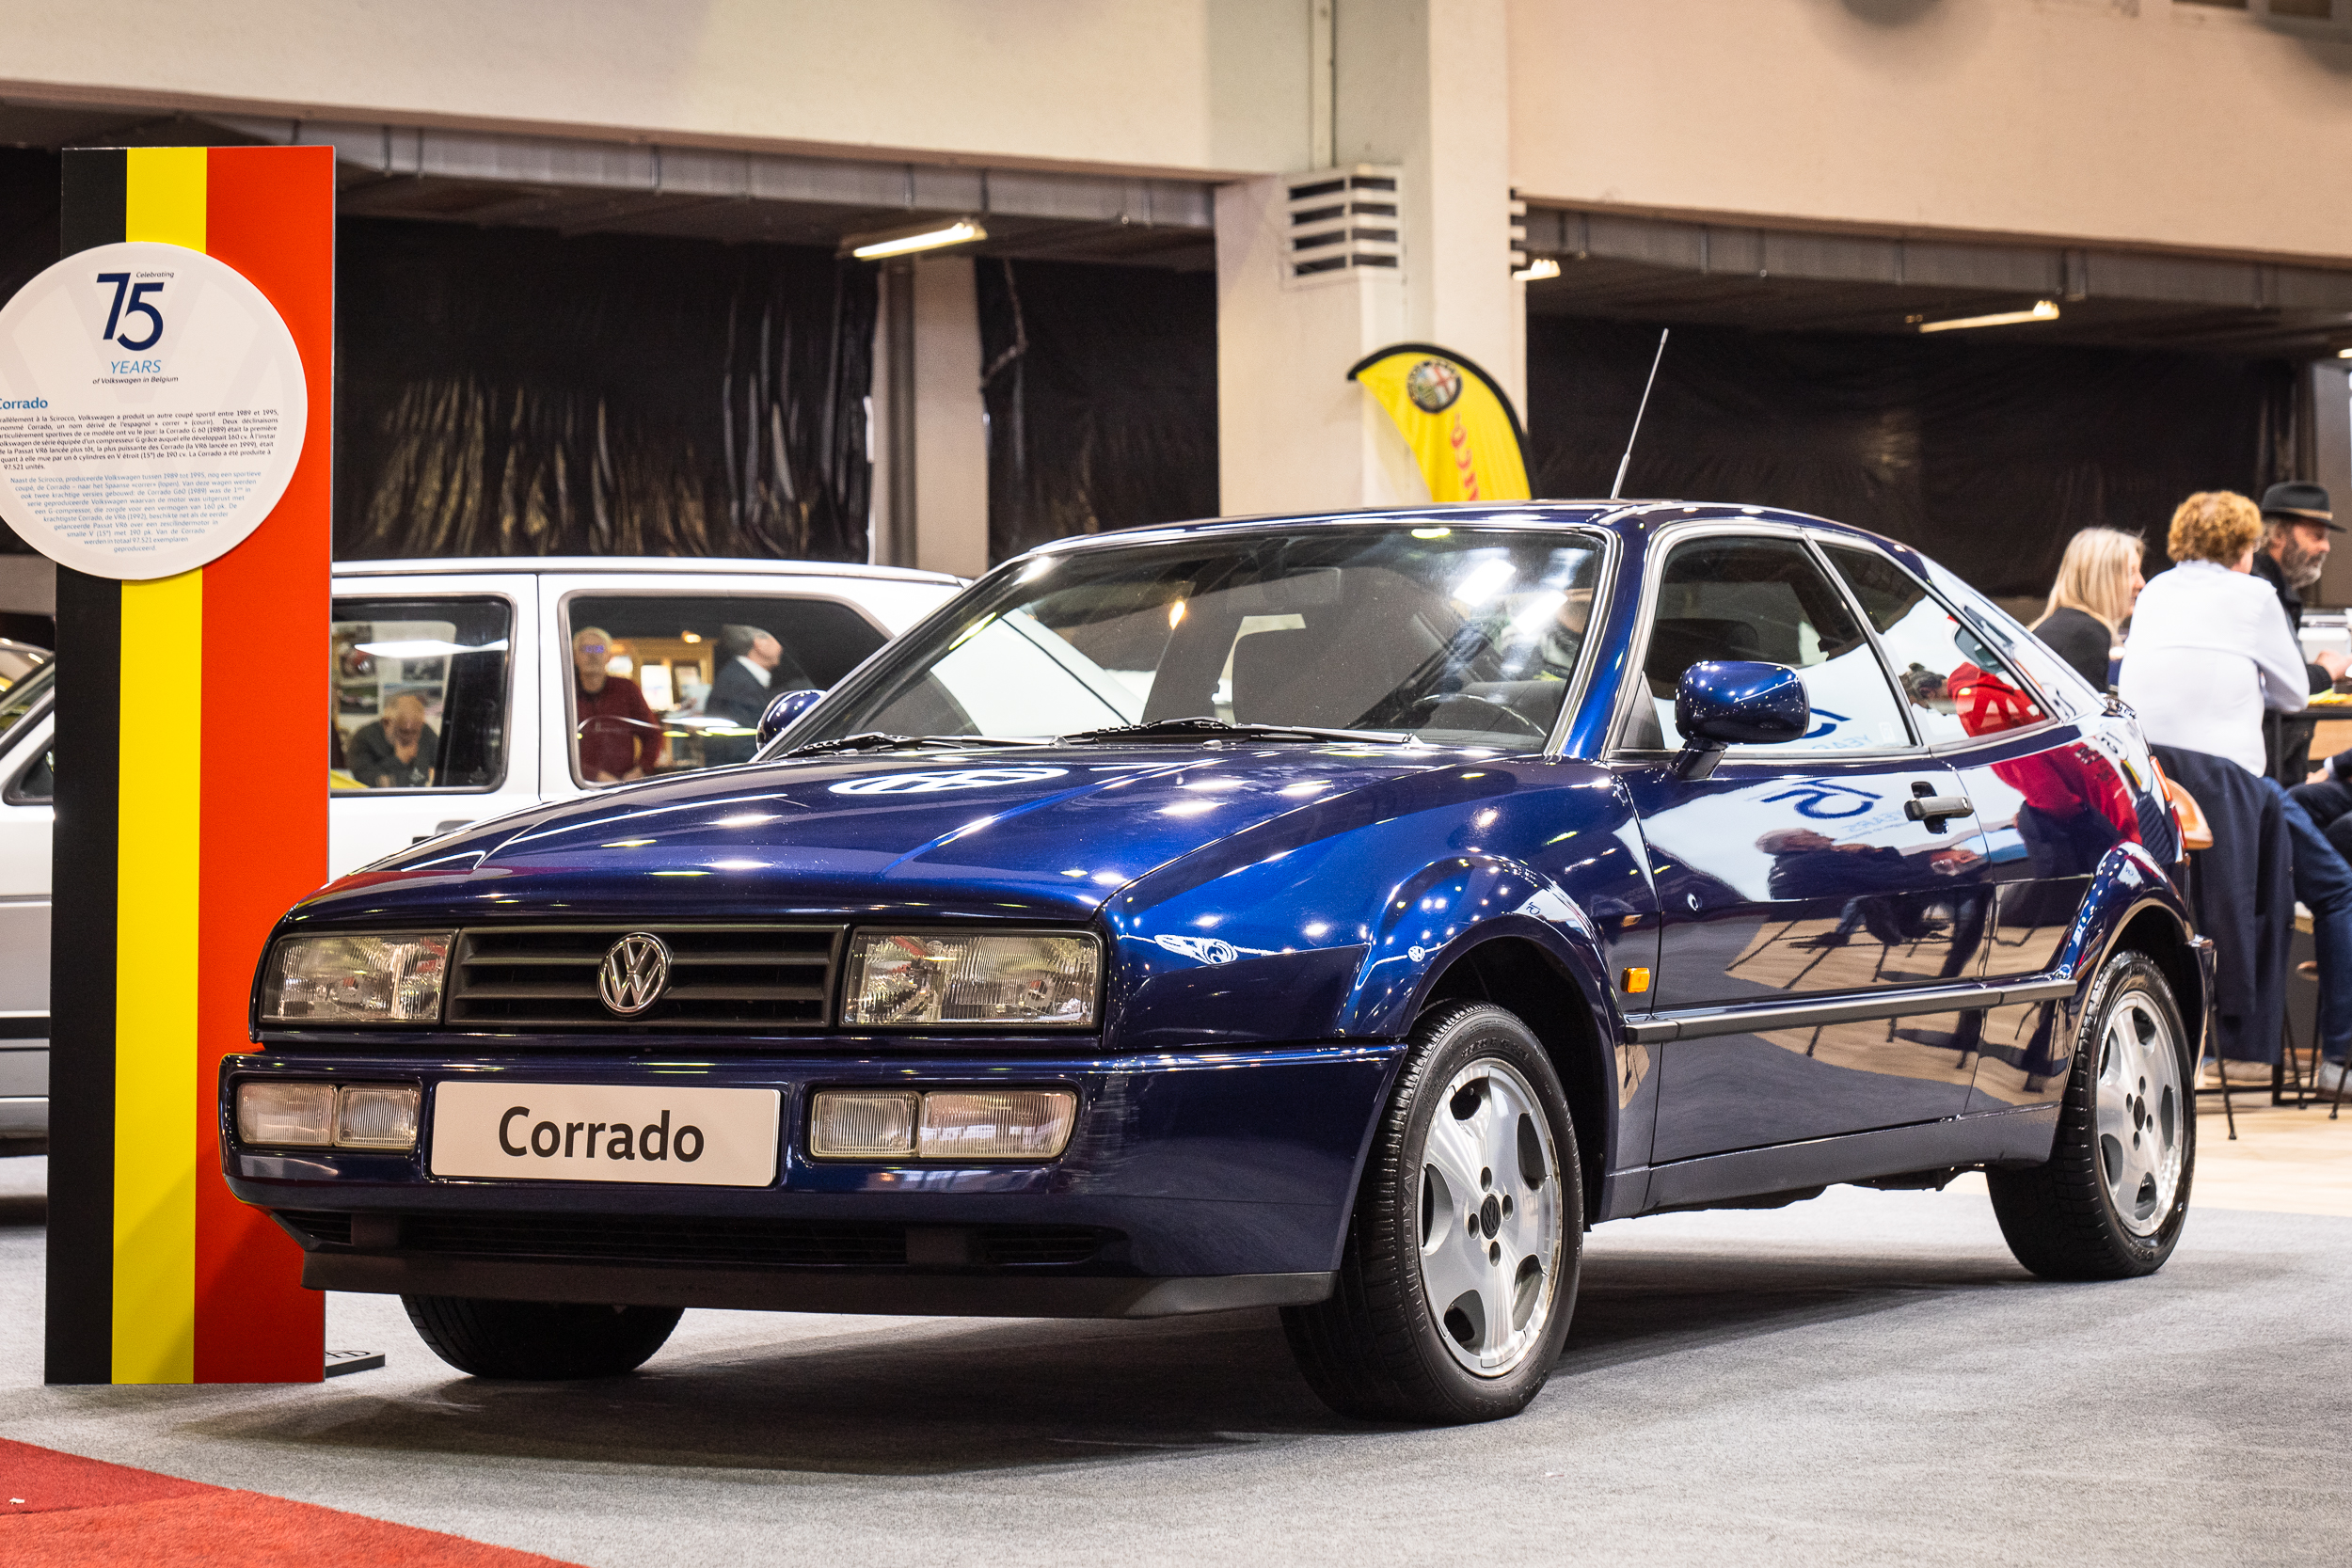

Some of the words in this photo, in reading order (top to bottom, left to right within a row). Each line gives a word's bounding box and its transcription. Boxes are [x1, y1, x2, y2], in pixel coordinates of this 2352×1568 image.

[96, 273, 165, 351] 75
[110, 359, 162, 373] YEARS
[101, 377, 142, 386] Volkswagen
[151, 375, 179, 384] Belgium
[50, 414, 75, 422] Scirocco,
[78, 413, 115, 422] Volkswagen
[122, 412, 145, 421] produit
[175, 411, 193, 420] coupé
[196, 410, 215, 420] sportif
[262, 408, 279, 417] 1995,
[27, 422, 53, 431] Corrado,
[120, 420, 151, 429] l'espagnol
[242, 416, 279, 424] déclinaisons
[45, 430, 72, 438] sportives
[207, 425, 227, 435] (1989)
[249, 424, 278, 433] première
[56, 437, 81, 446] équipée
[140, 436, 158, 444] grâce
[158, 435, 179, 443] auquel
[191, 433, 227, 442] développait
[70, 445, 83, 453] plus
[103, 444, 117, 453] plus
[118, 443, 147, 452] puissante
[185, 442, 194, 451] (la
[0, 455, 18, 464] quant
[79, 452, 106, 462] cylindres
[240, 448, 265, 457] produite
[499, 1106, 705, 1163] Corrado
